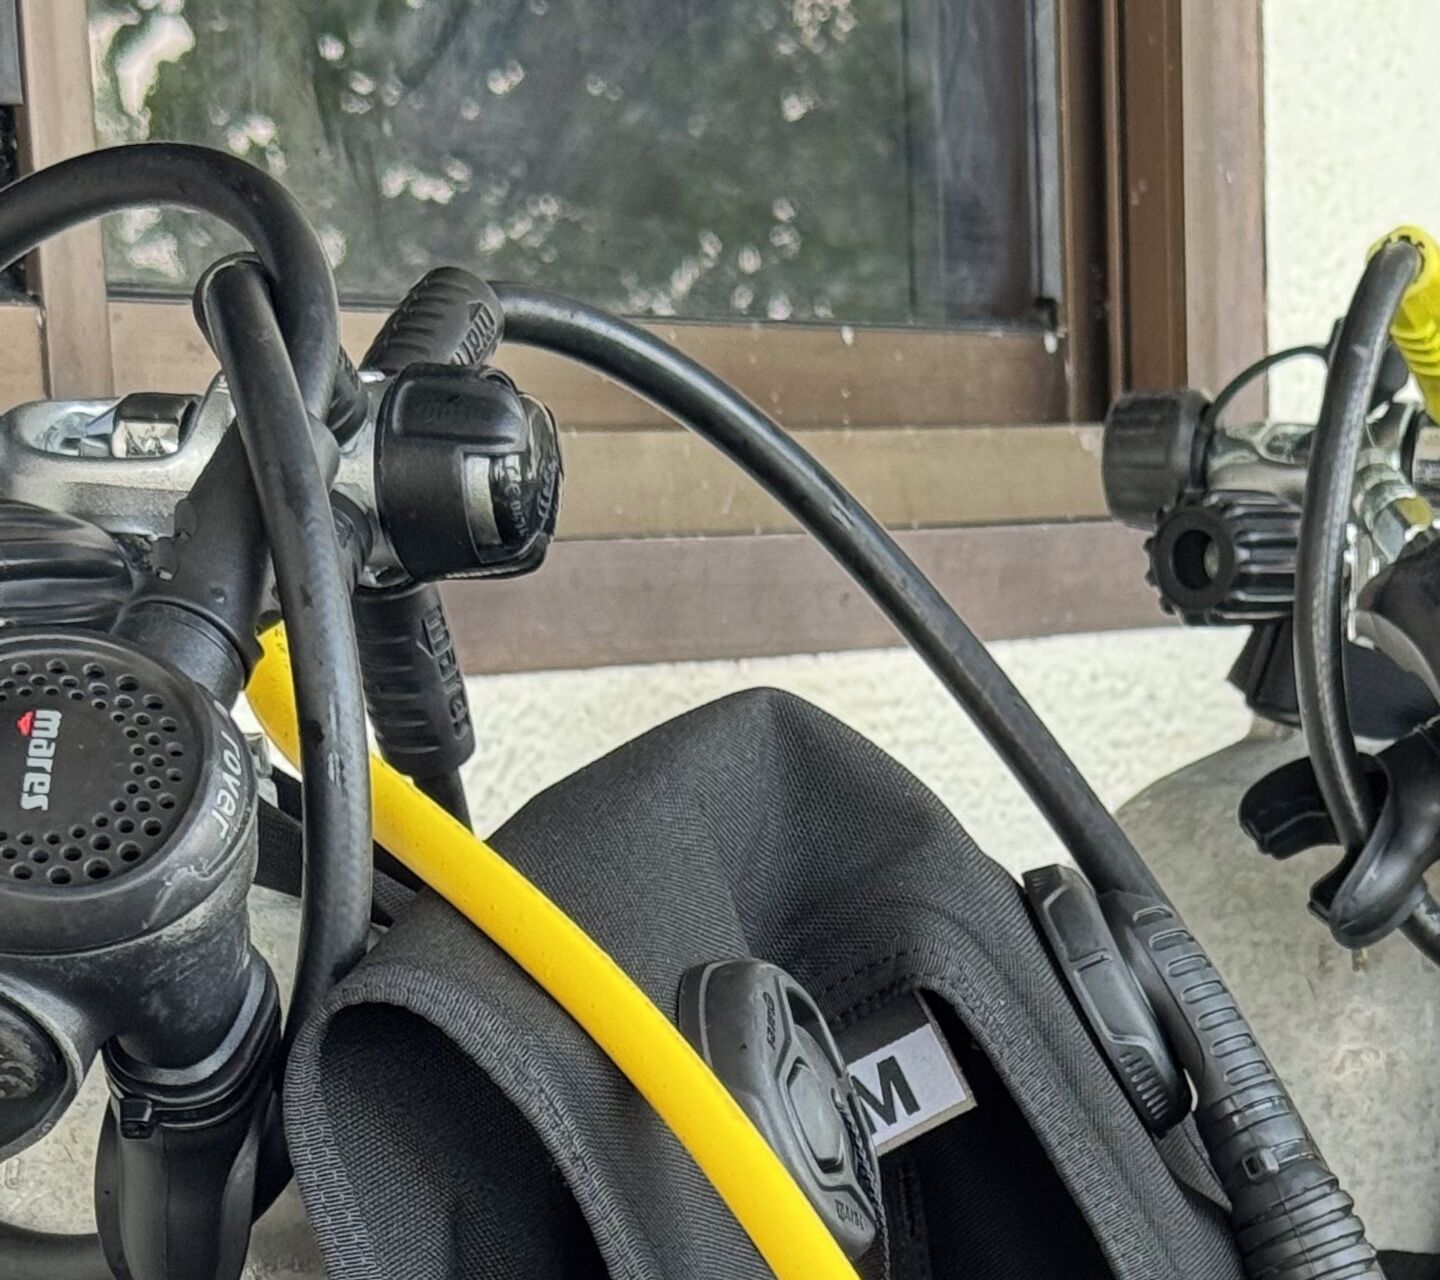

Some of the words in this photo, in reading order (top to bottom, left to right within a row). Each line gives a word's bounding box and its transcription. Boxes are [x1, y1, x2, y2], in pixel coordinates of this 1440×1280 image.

[20, 708, 62, 812] mares
[211, 729, 243, 841] rover
[850, 1054, 921, 1136] M
